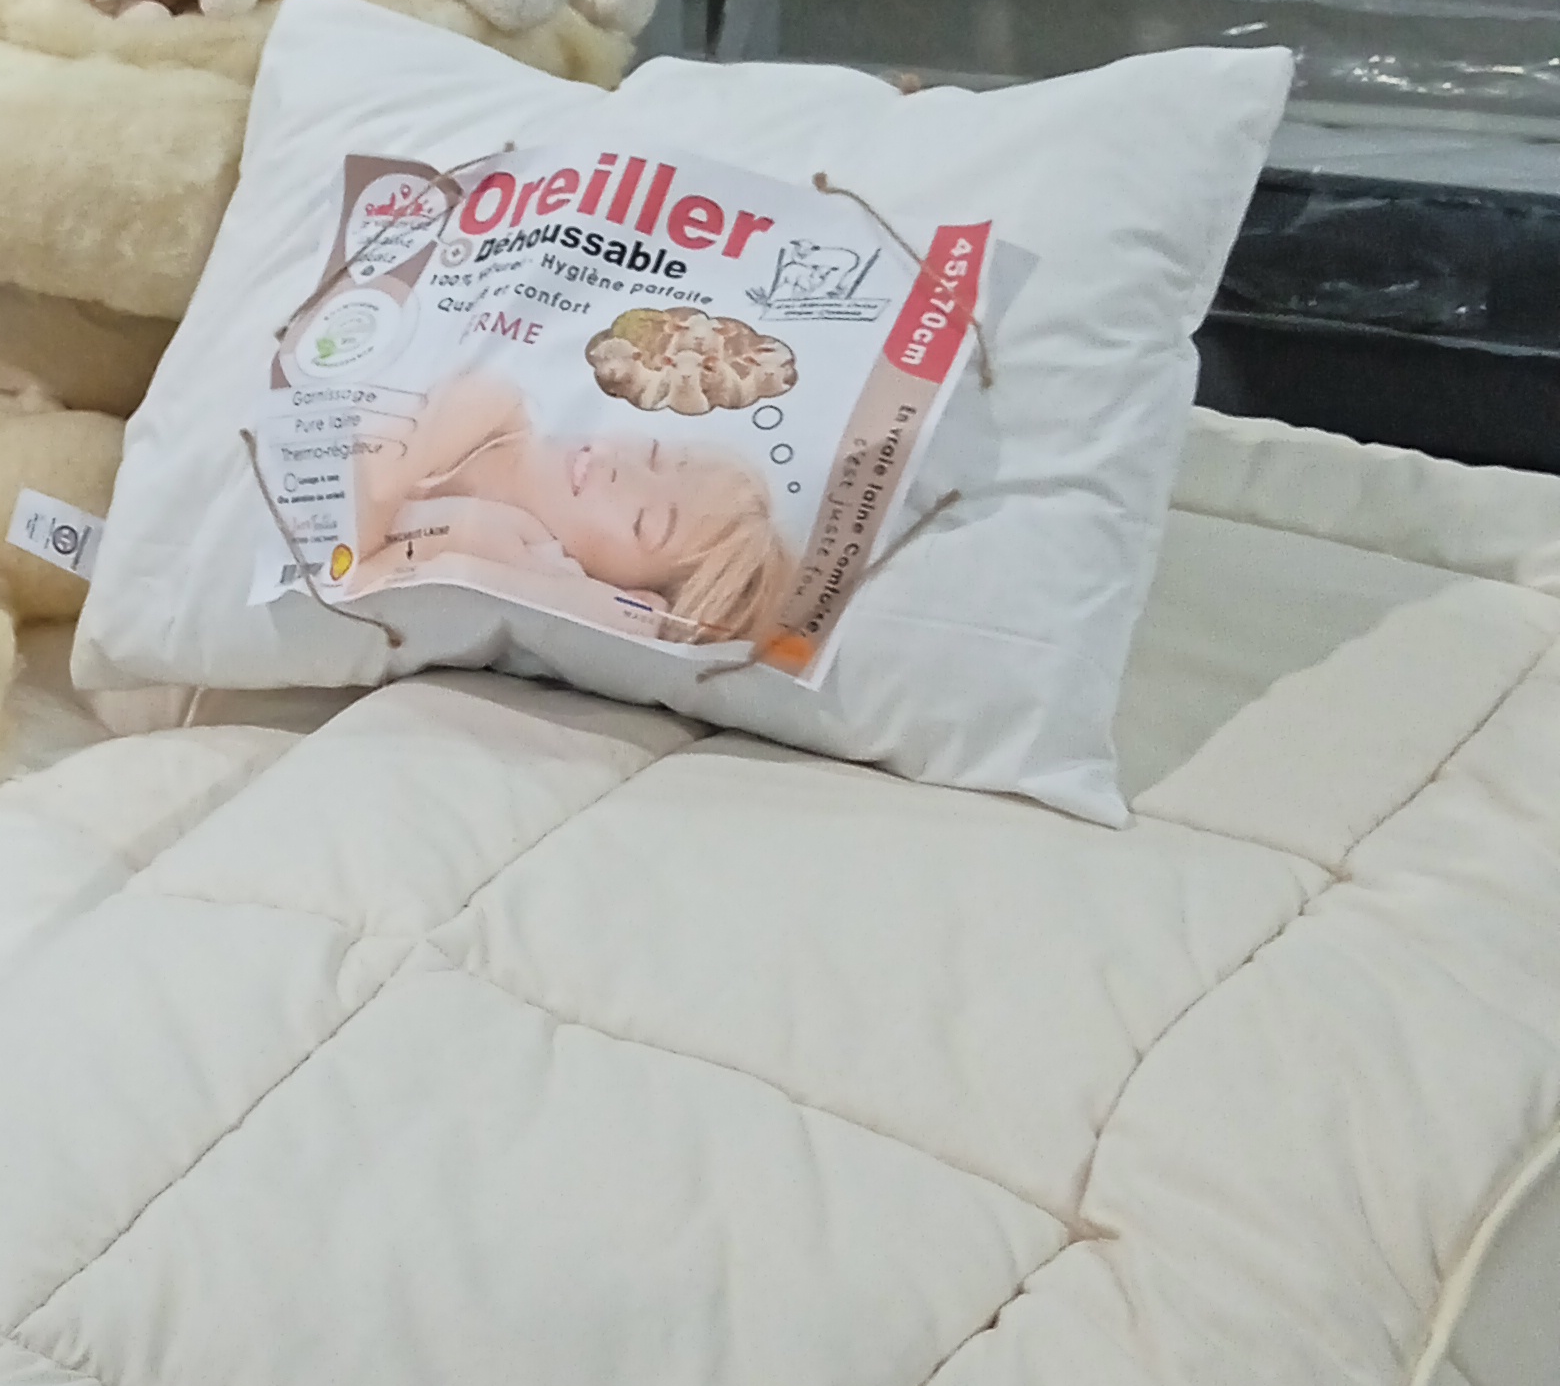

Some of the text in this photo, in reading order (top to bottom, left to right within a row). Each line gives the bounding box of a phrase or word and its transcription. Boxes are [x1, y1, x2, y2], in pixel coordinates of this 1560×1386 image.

[459, 152, 775, 259] Oreiller
[474, 224, 688, 279] Déhoussable
[513, 282, 591, 314] confort
[540, 253, 624, 292] Hygiène
[629, 282, 714, 305] parfaite
[900, 237, 974, 365] 45x70cm
[873, 428, 903, 476] vraie
[851, 483, 884, 535] laine
